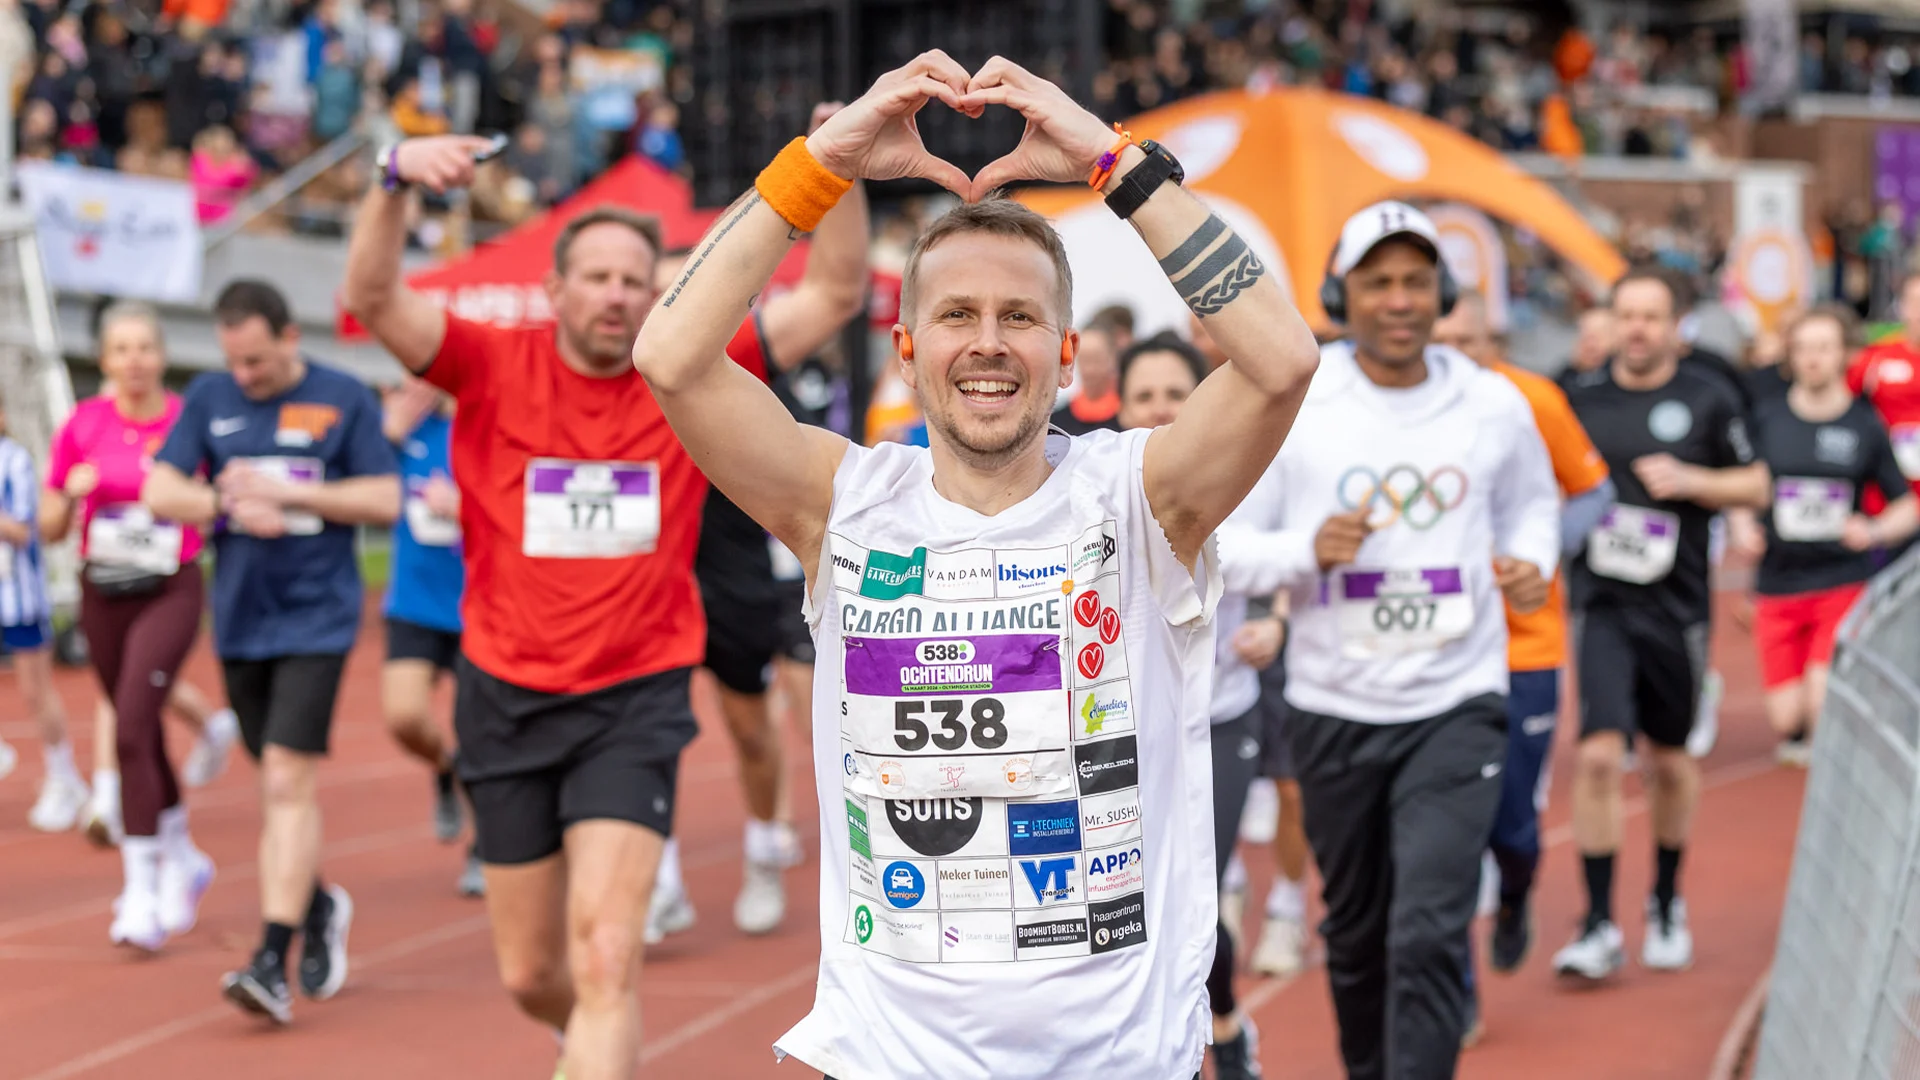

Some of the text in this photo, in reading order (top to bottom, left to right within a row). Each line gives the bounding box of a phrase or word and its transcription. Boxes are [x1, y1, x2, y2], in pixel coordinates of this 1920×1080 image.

[674, 287, 682, 295] is
[570, 503, 614, 530] 171
[831, 554, 861, 575] MORE
[927, 567, 992, 581] VANDAM
[998, 563, 1067, 581] bisous
[1372, 603, 1438, 631] 007
[923, 644, 959, 661] 538
[900, 663, 993, 684] OCHTENDRUN
[893, 697, 1008, 751] 538
[1032, 817, 1075, 831] I-TECHNIEK
[1084, 805, 1139, 827] Mr. SUSHI
[1089, 848, 1141, 875] APPO
[939, 867, 1009, 880] Meker Tuinen
[1019, 856, 1076, 905] VT
[888, 890, 919, 900] Camigoo
[1041, 886, 1075, 898] Transport
[1093, 902, 1141, 923] haarcentrum
[1112, 920, 1142, 940] ugeka
